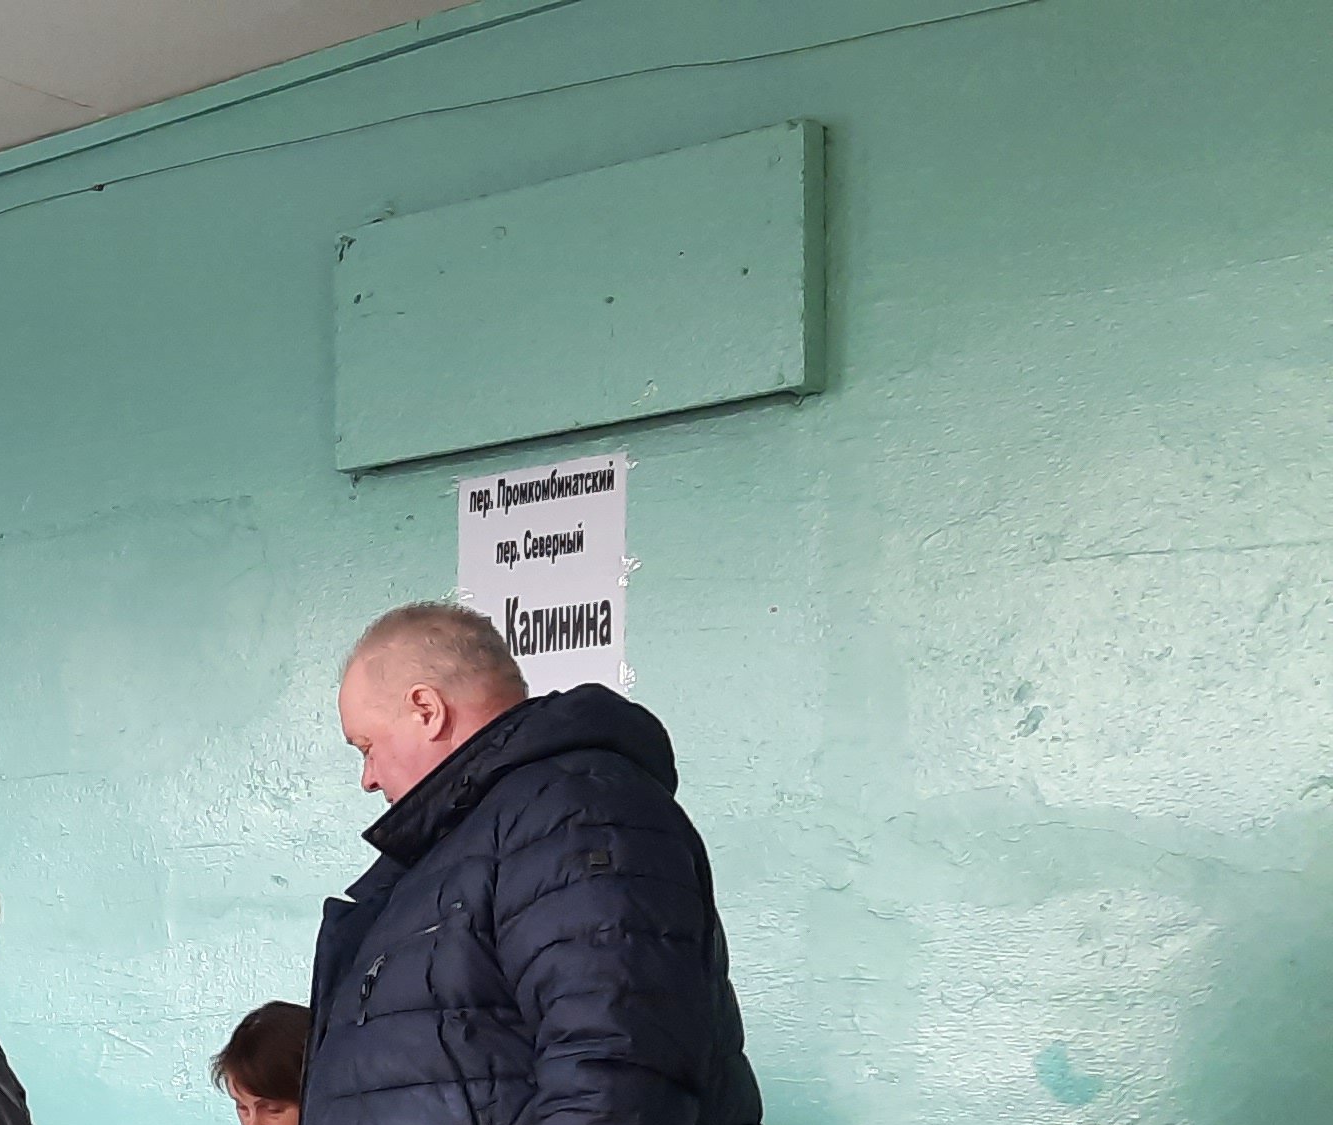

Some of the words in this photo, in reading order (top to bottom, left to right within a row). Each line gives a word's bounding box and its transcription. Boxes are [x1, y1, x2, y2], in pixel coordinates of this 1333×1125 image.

[469, 487, 493, 518] пер.
[497, 461, 615, 515] Промкомбинатский
[496, 540, 520, 570] пер.
[523, 521, 585, 565] Северный
[505, 596, 612, 657] Калинина
